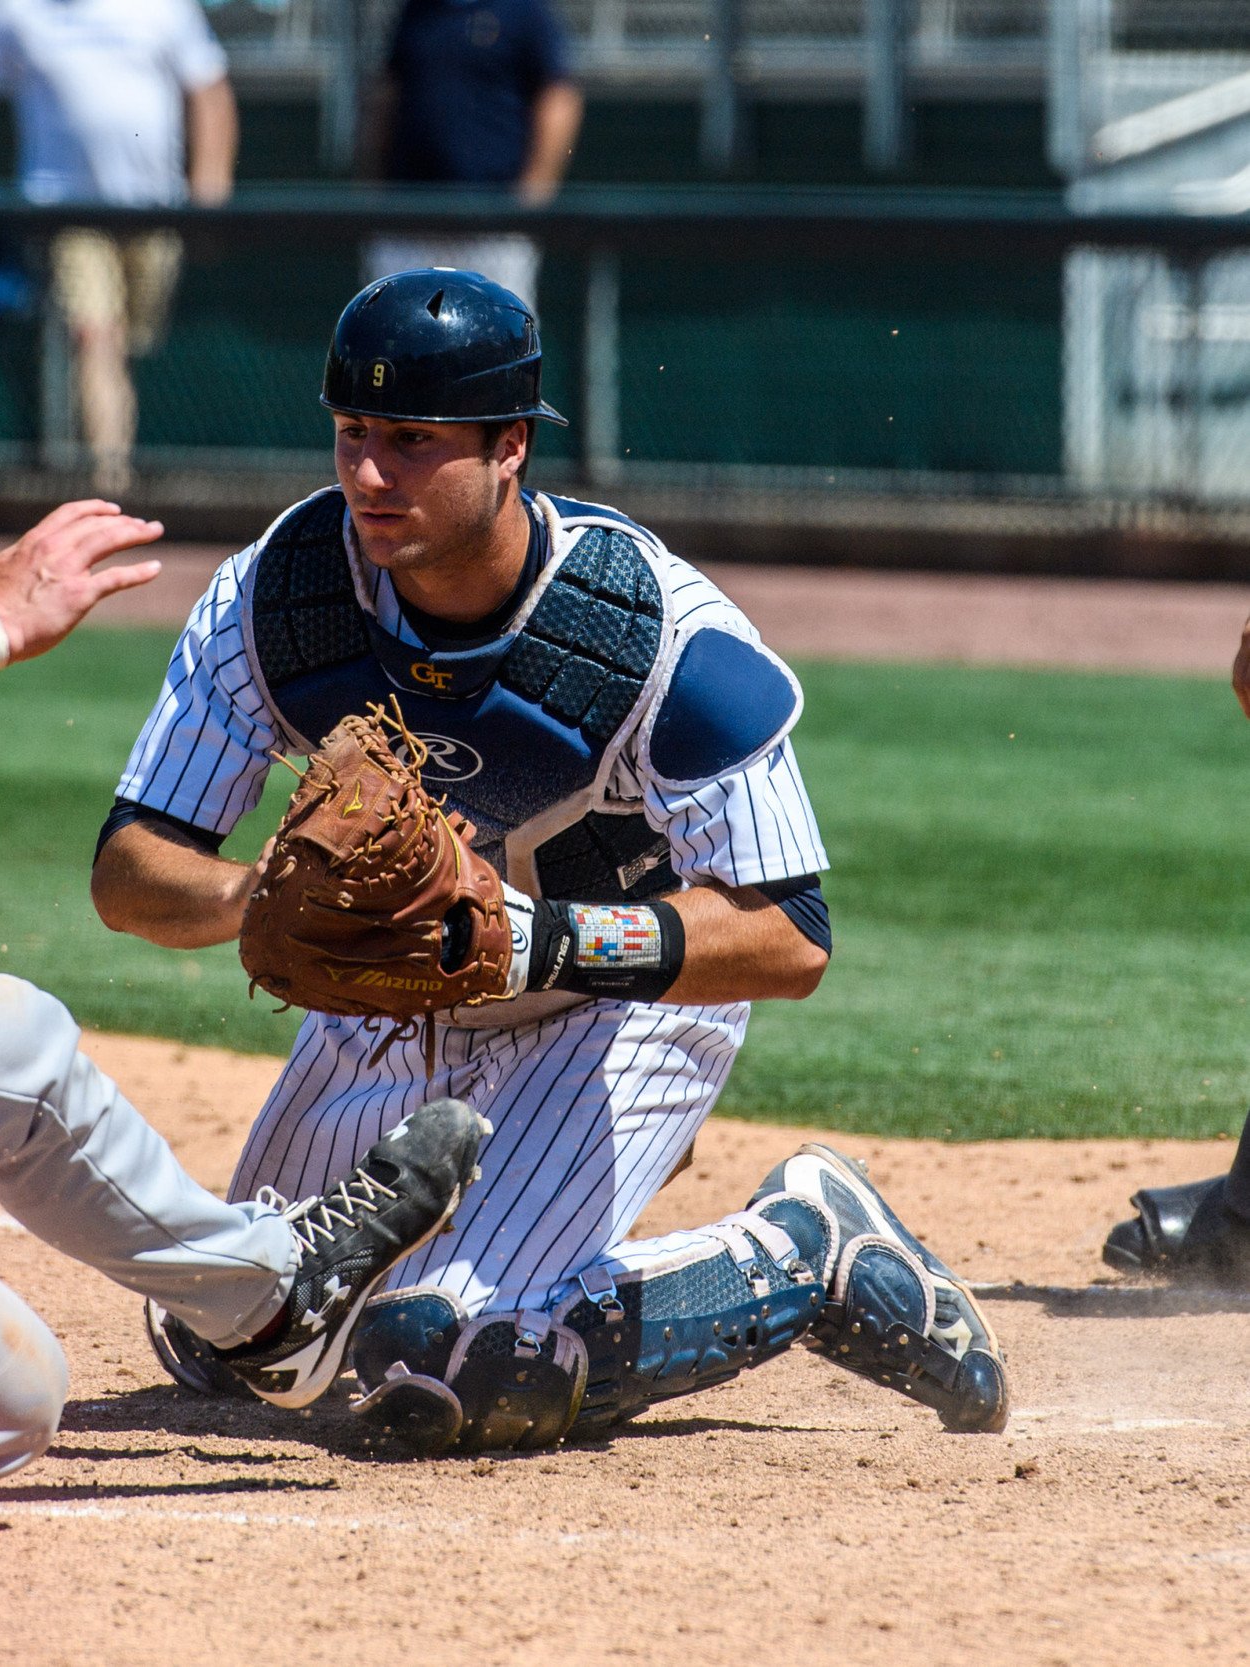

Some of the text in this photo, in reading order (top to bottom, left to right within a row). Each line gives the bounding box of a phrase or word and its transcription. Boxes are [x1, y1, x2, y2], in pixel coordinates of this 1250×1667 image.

[372, 363, 385, 387] 9
[410, 662, 453, 689] GT
[542, 934, 571, 990] RAWLINGS
[352, 970, 443, 992] MIZUNO
